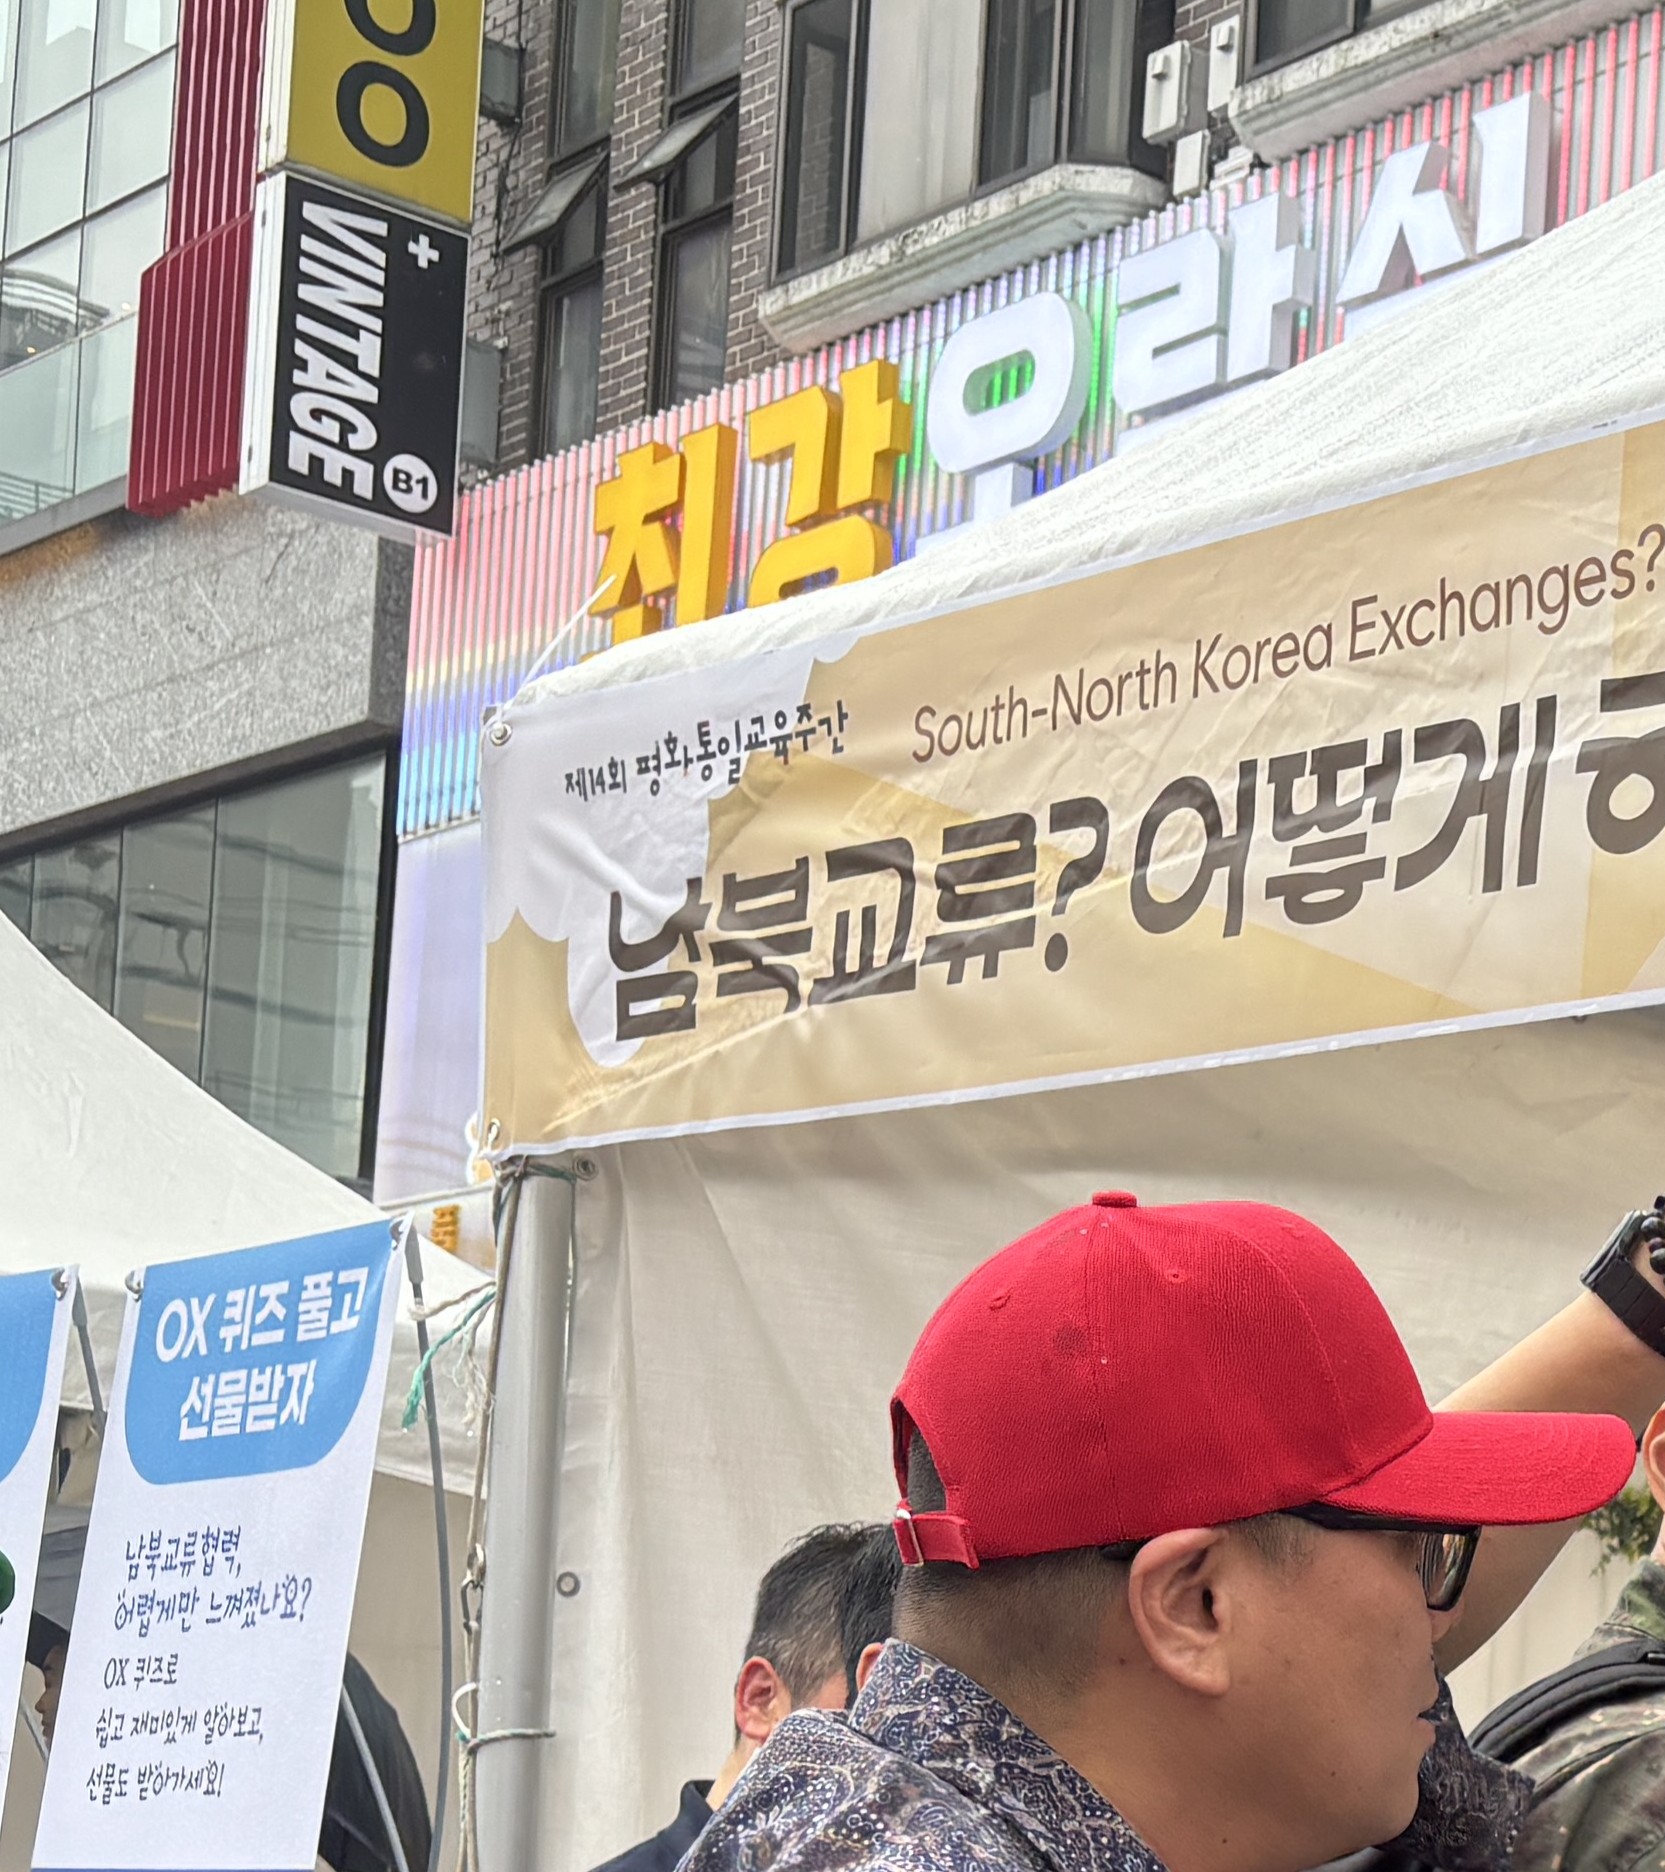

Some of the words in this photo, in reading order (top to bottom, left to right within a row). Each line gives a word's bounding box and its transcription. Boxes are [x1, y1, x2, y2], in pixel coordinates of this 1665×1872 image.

[287, 201, 389, 502] VINTAGE
[390, 466, 431, 501] B1
[912, 651, 1178, 765] South-North
[1193, 622, 1333, 700] Korea
[1348, 522, 1665, 662] Exchanges?
[564, 755, 628, 802] 제14회
[635, 699, 849, 797] 평화통일교육주간
[609, 796, 1110, 1042] 남북교류?
[1129, 693, 1557, 938] 어떻게
[155, 1295, 214, 1364] OX
[217, 1286, 288, 1354] 퀴즈
[295, 1265, 370, 1338] 풀고
[177, 1358, 319, 1443] 선물받자
[103, 1657, 130, 1689] OX
[95, 1706, 125, 1748] 쉽고
[130, 1706, 198, 1744] 재미있게
[86, 1763, 130, 1805] 선물도
